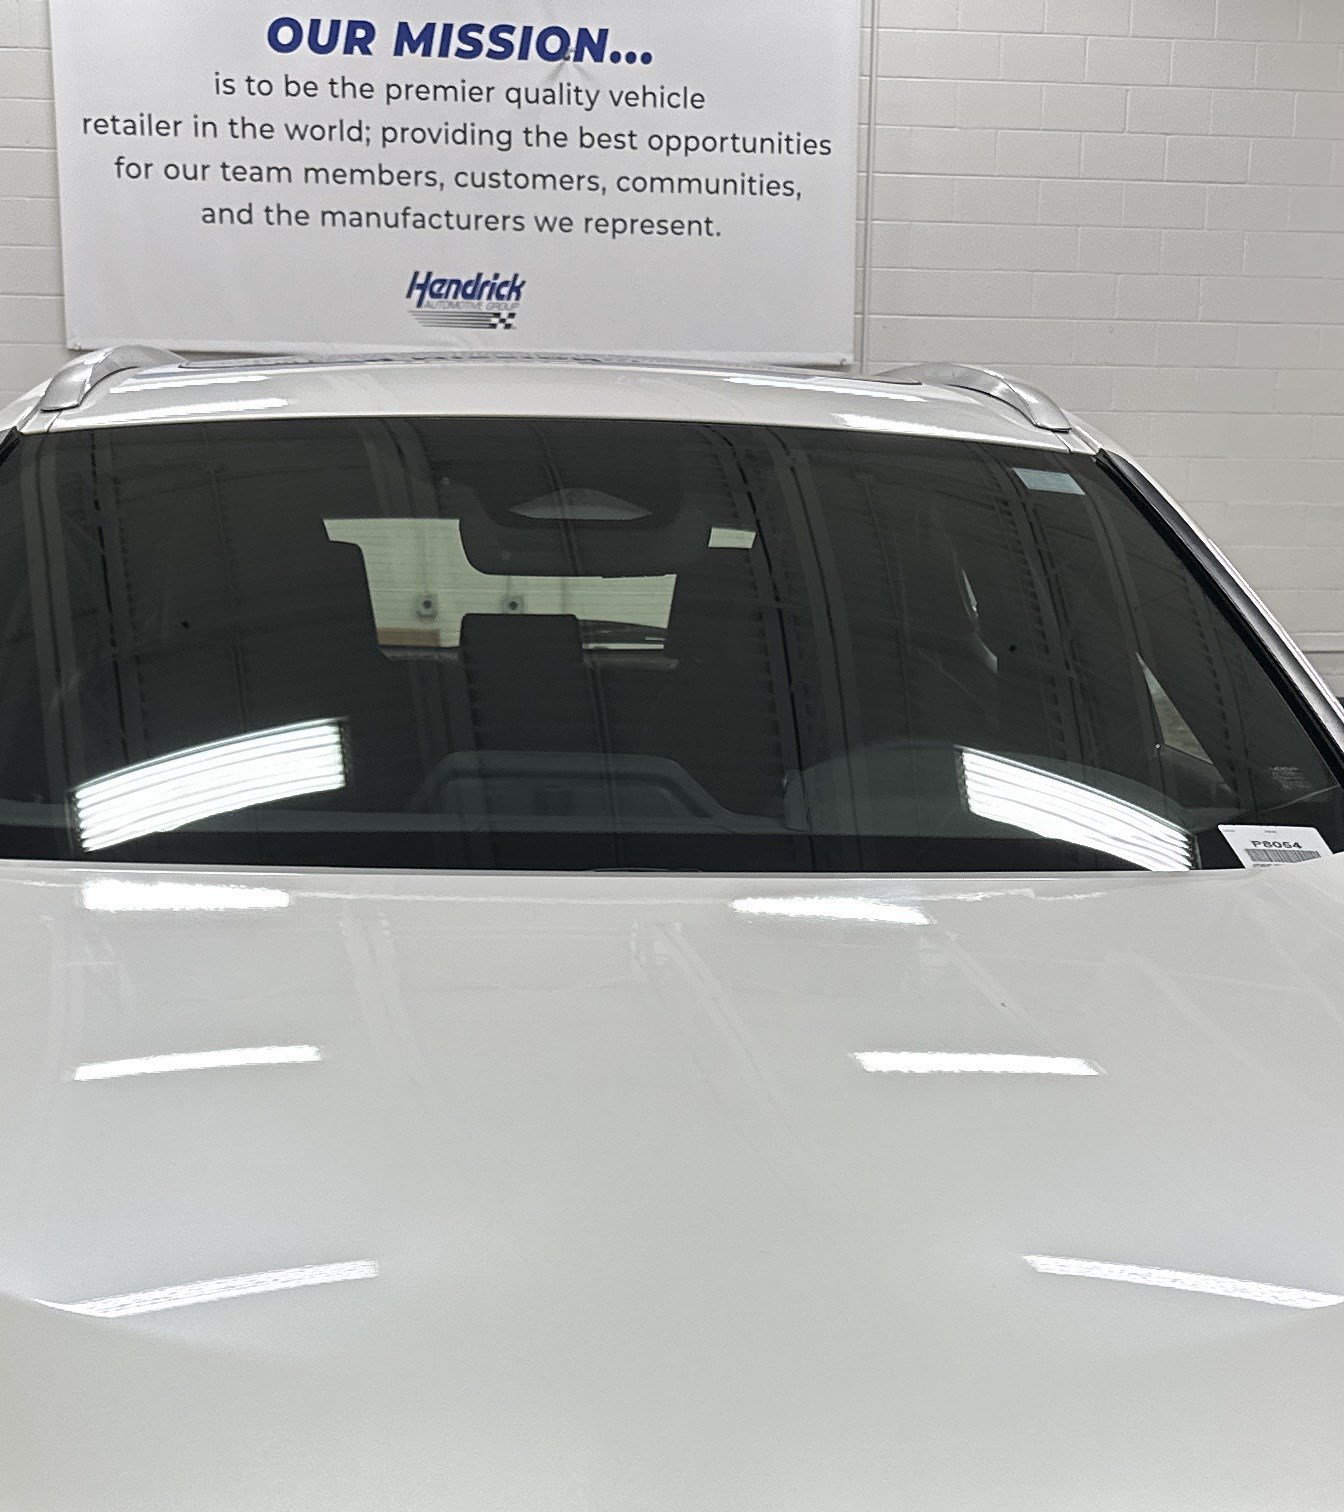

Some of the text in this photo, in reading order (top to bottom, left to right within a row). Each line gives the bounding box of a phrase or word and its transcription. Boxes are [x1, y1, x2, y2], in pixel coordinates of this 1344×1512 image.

[266, 16, 653, 65] OUR MISSION...
[214, 70, 706, 112] is to be the premier quality vehicle
[82, 111, 832, 158] retailer in the world; providing the best opportunities
[113, 155, 802, 202] for our team members, customers, communities,
[201, 201, 721, 240] and the manufacturers we represent.
[406, 271, 526, 308] Hendrick
[1250, 840, 1303, 849] P8054
